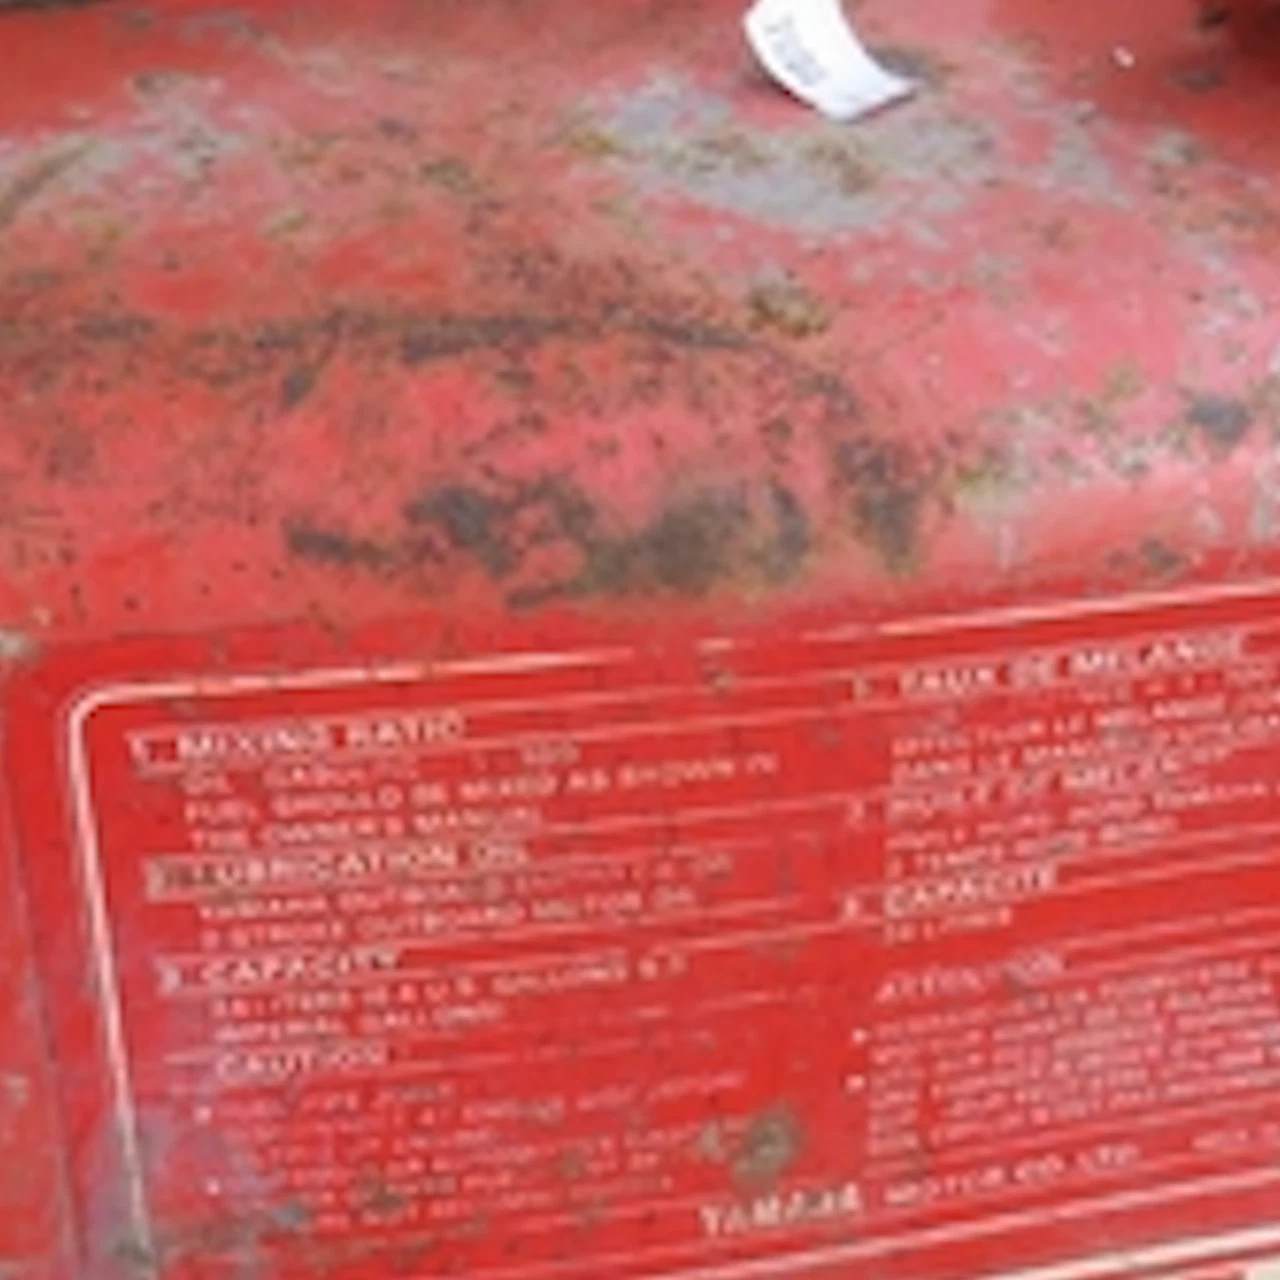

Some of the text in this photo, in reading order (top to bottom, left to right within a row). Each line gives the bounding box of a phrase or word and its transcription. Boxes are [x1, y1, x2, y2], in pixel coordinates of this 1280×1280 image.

[177, 721, 330, 760] MIXING
[344, 708, 467, 752] RATIO
[272, 782, 403, 818] SHOULD
[410, 780, 450, 809] BE
[458, 772, 558, 802] MIXED
[569, 767, 611, 794] AS
[616, 756, 736, 789] SHOWN
[187, 825, 249, 851] THE
[194, 841, 457, 886] LUBRICATION
[472, 839, 531, 873] OIL
[200, 948, 398, 985] CAPACITY
[217, 1042, 390, 1078] CAUTION
